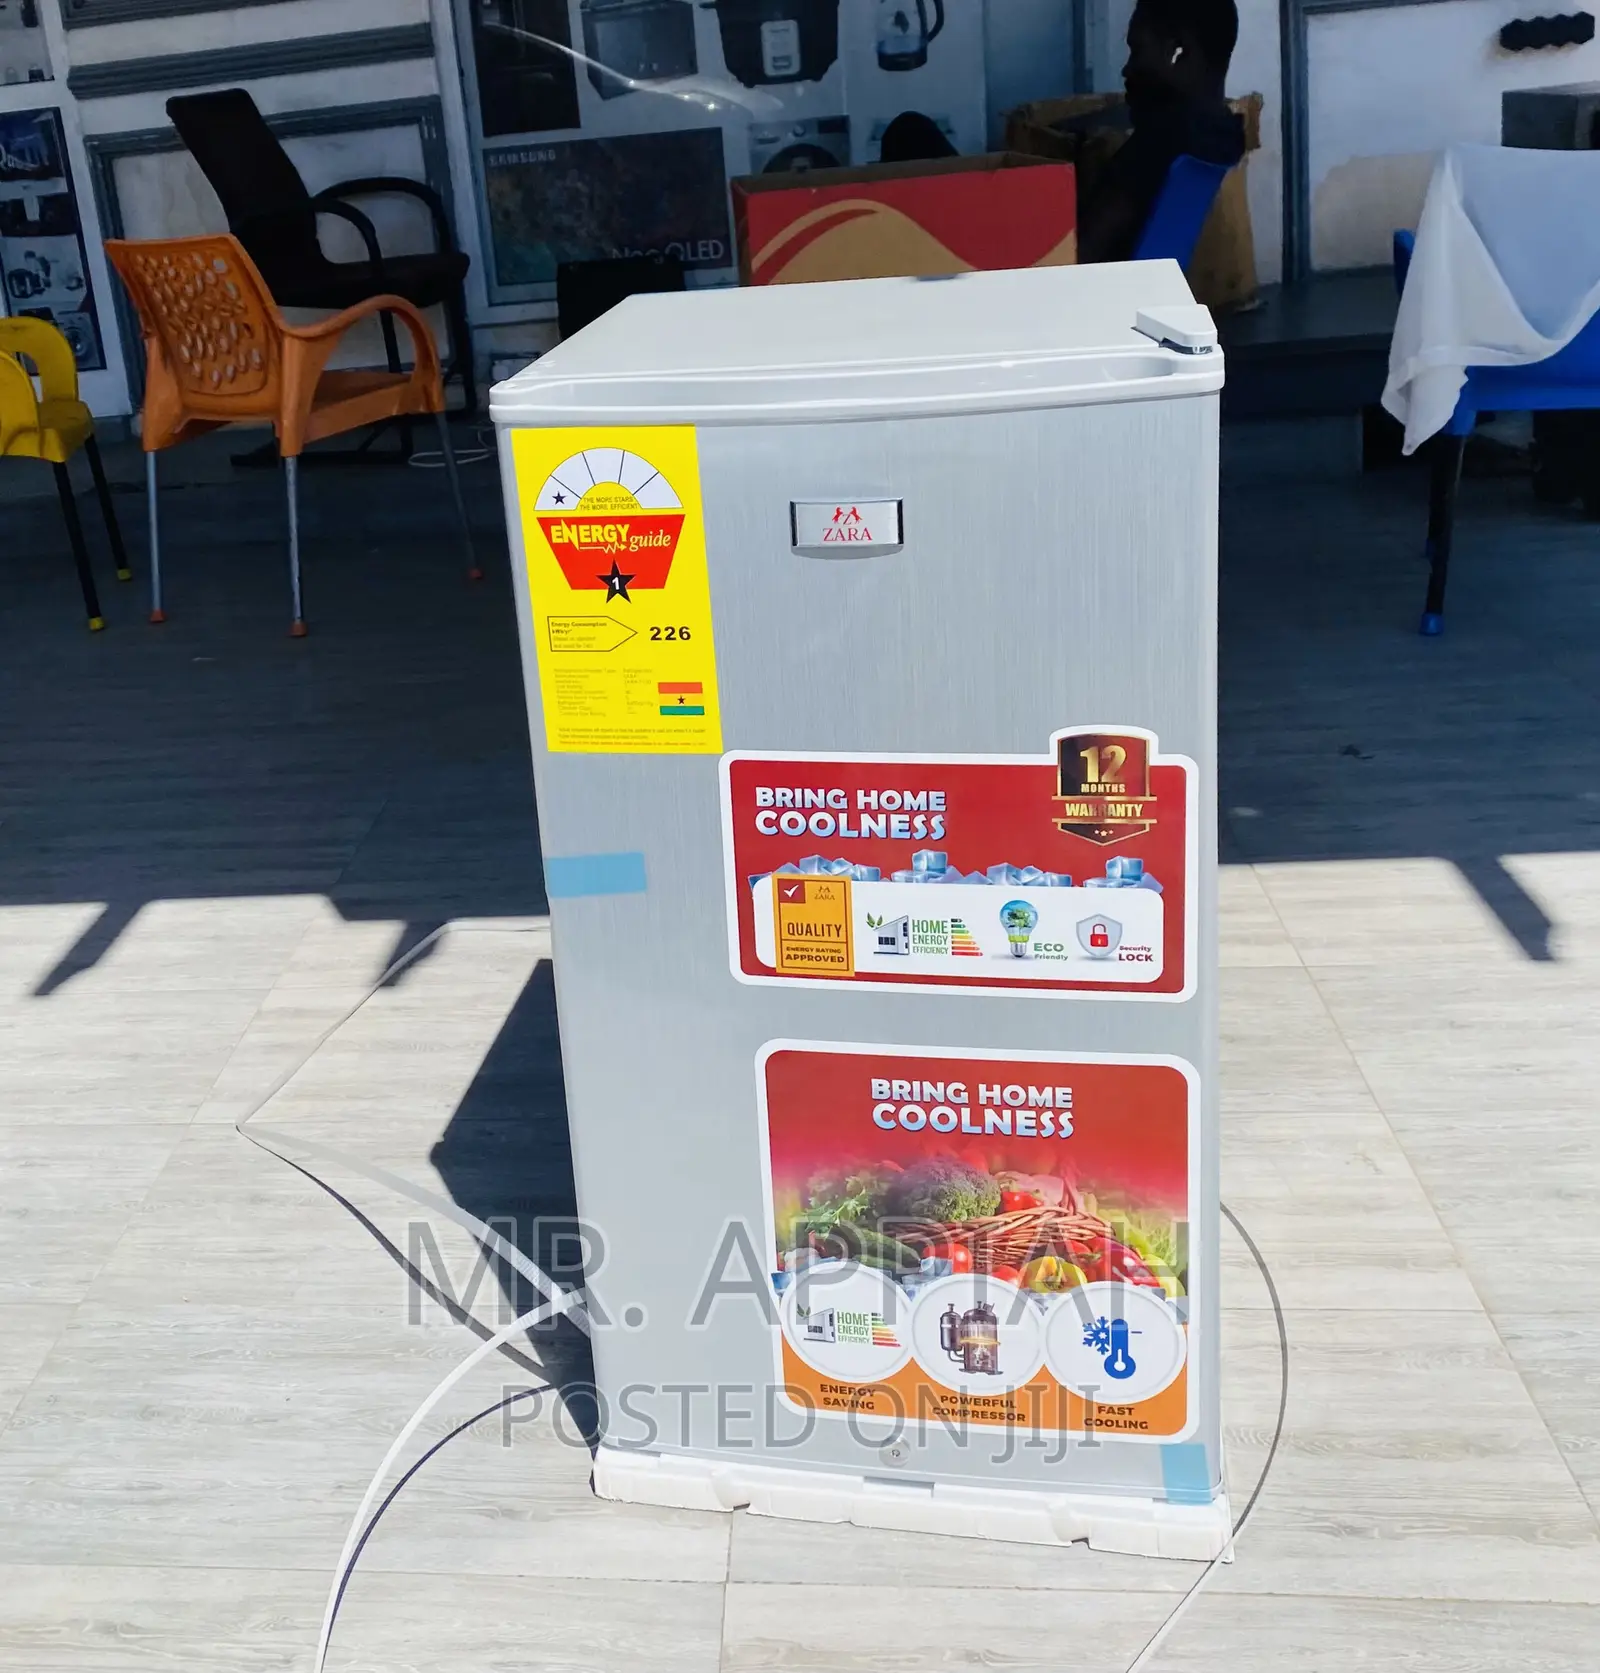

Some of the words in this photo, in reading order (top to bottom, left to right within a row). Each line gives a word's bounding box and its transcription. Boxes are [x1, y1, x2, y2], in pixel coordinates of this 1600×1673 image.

[664, 239, 725, 261] QLED
[551, 519, 630, 550] ENERGY
[629, 530, 671, 552] guide
[822, 527, 873, 542] ZARA
[611, 576, 620, 590] 1
[649, 626, 692, 641] 226
[1080, 744, 1126, 783] 12
[1080, 783, 1126, 793] MONTHS
[755, 786, 849, 810] BRING
[856, 788, 947, 812] HOME
[1065, 803, 1143, 817] WARRANTY
[754, 810, 946, 841] COOLNESS
[787, 922, 842, 938] QUALITY
[911, 918, 949, 934] HOME
[912, 934, 949, 946] ENERGY
[912, 945, 949, 955] EFFICIENCY
[1033, 942, 1065, 953] ECO
[1119, 945, 1152, 953] Security
[785, 954, 845, 963] APPROVED
[1034, 954, 1069, 962] Friendly
[1118, 953, 1154, 963] LOCK
[870, 1078, 970, 1105] BRING
[978, 1083, 1074, 1109] HOME
[872, 1102, 1075, 1139] COOLNESS
[836, 1310, 870, 1326] HOME
[837, 1324, 870, 1337] ENERGY
[837, 1335, 870, 1344] EFFICIENCY
[819, 1383, 877, 1398] ENERGY
[823, 1397, 875, 1410] SAVING
[940, 1394, 1017, 1409] POWERFUL
[932, 1406, 1026, 1423] COMPRESSOR
[1097, 1405, 1135, 1417] FAST
[1083, 1417, 1149, 1430] COOLING
